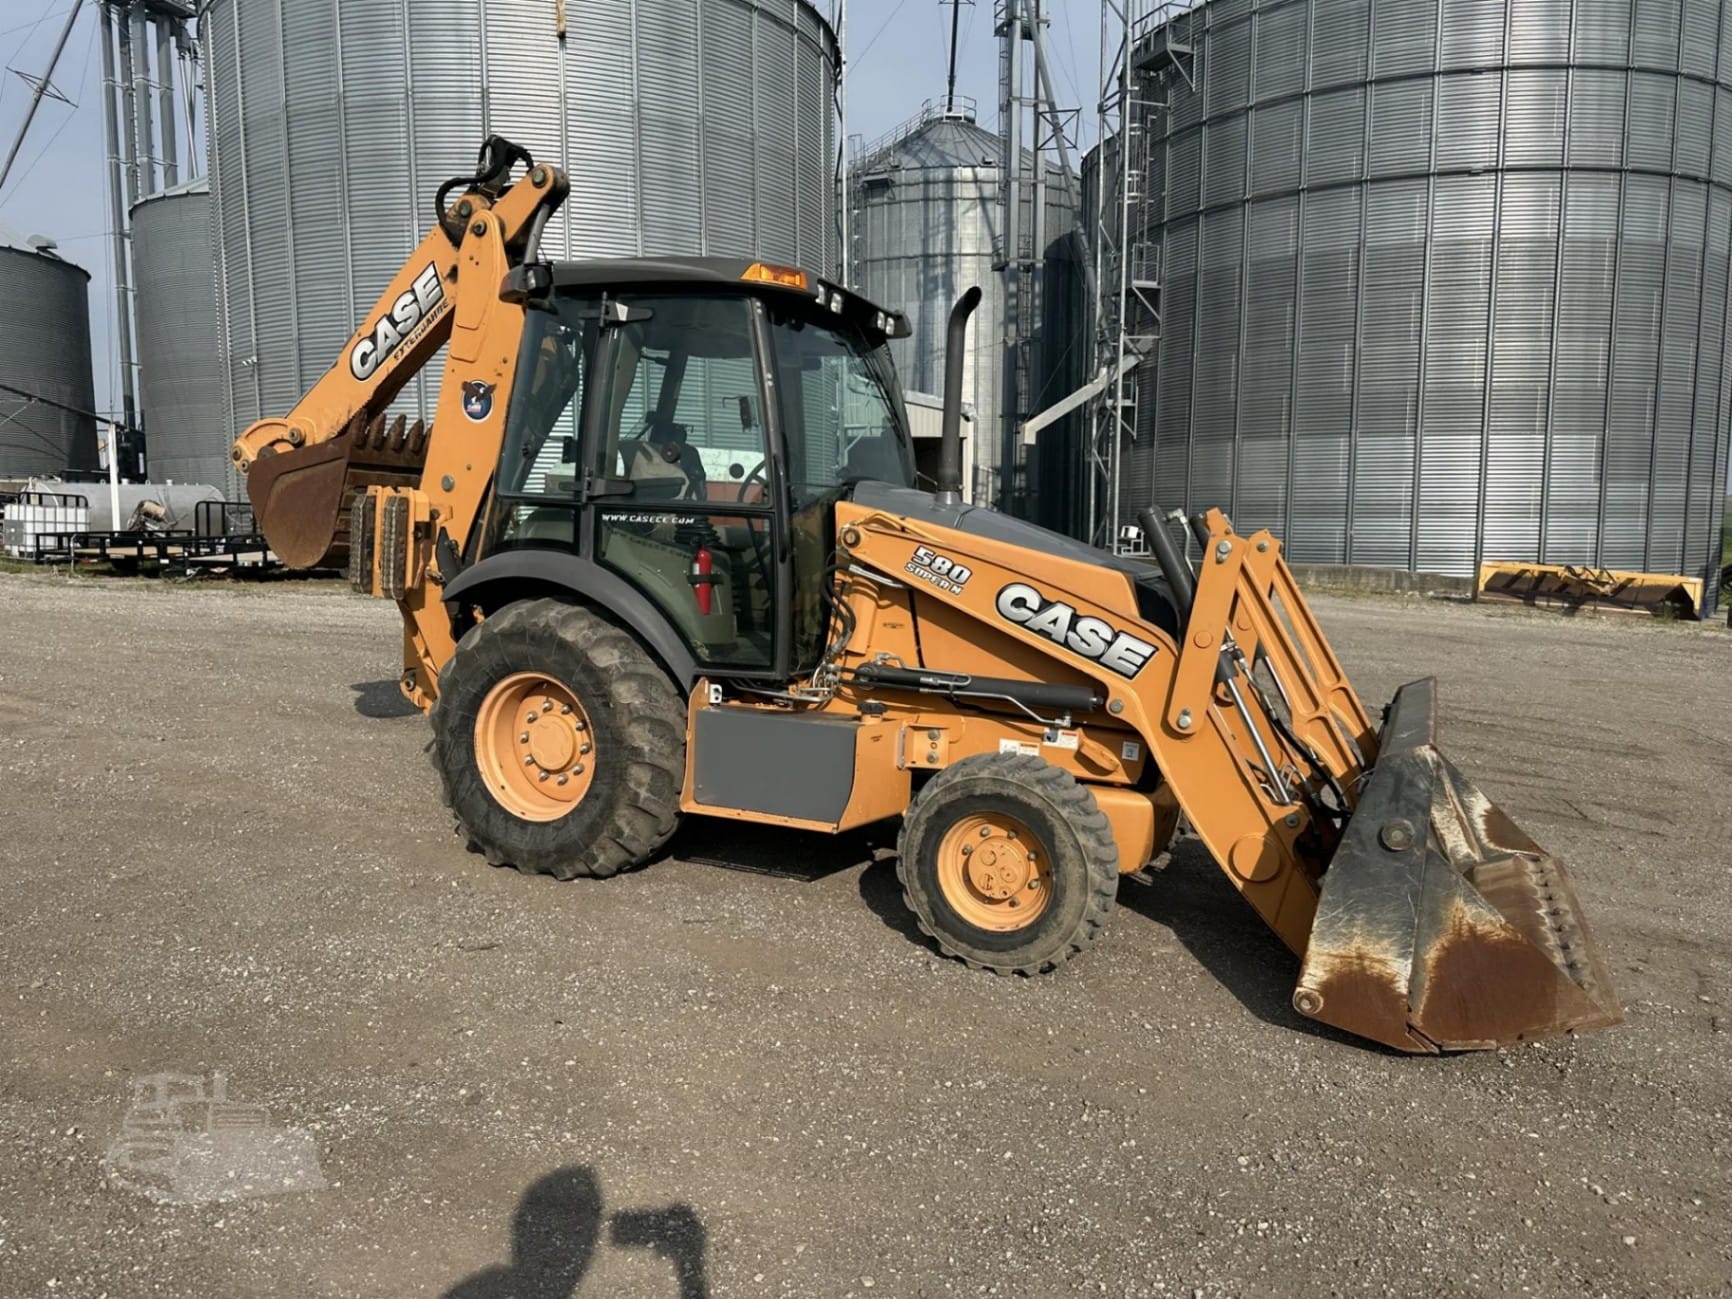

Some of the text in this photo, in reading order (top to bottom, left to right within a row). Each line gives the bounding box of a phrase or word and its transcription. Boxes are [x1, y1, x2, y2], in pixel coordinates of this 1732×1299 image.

[351, 261, 444, 380] CASE
[904, 563, 963, 595] SUPER N
[911, 545, 972, 585] 580
[996, 582, 1159, 680] CASE
